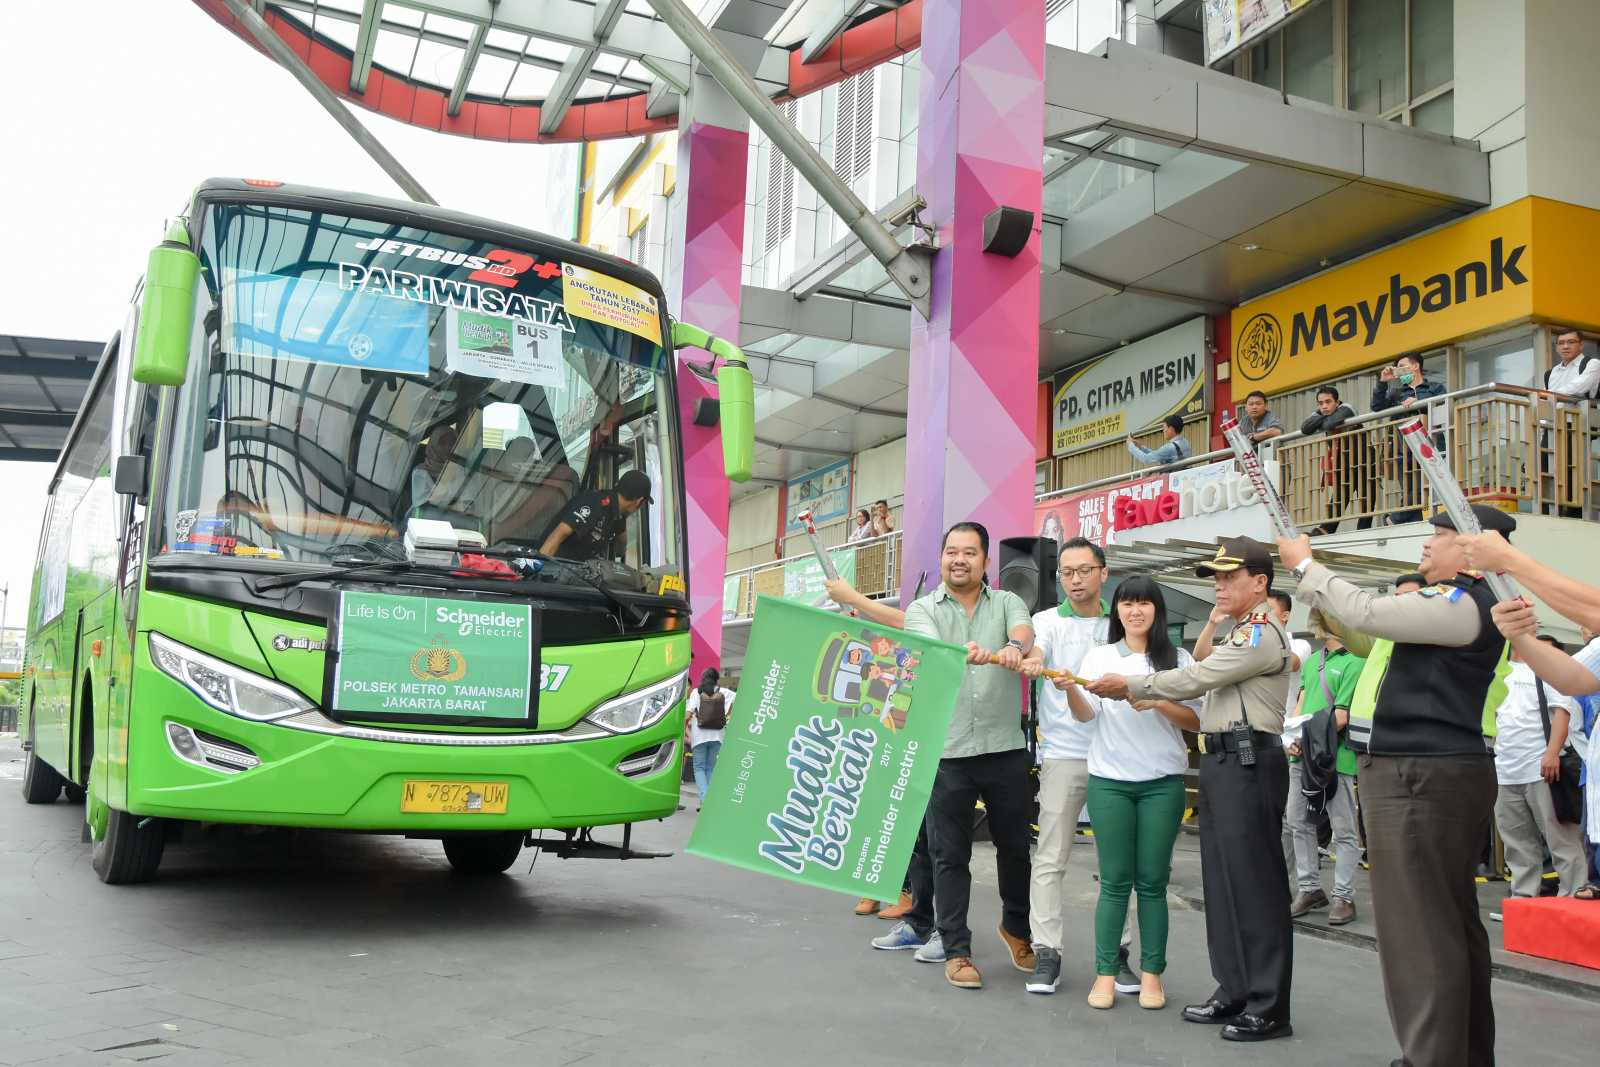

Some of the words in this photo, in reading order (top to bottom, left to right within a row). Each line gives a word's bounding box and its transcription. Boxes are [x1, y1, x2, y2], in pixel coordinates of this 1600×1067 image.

[355, 238, 490, 270] JETBUS
[338, 261, 576, 333] PARIWISATA
[570, 279, 619, 300] ANGKUTAN
[620, 294, 656, 316] LEBARAN
[590, 293, 620, 309] TAHUN
[621, 303, 641, 317] 2017
[1290, 236, 1528, 358] Maybank
[517, 324, 549, 340] BUS
[526, 340, 540, 359] 1
[1059, 397, 1082, 424] PD.
[1087, 376, 1135, 411] CITRA
[1140, 354, 1197, 395] MESIN
[1065, 433, 1082, 446] (021)
[1083, 429, 1096, 441] 300
[1098, 426, 1106, 437] 12
[1107, 422, 1121, 434] 777
[1079, 497, 1100, 517] SALE
[1078, 513, 1103, 538] 70%
[347, 603, 374, 618] Life
[377, 605, 390, 619] Is
[436, 606, 525, 628] Schneider
[474, 626, 523, 638] Electric
[343, 680, 397, 693] POLSEK
[400, 682, 447, 696] METRO
[453, 685, 525, 699] TAMANSARI
[748, 659, 781, 735] Schneider
[769, 664, 791, 707] Electric
[381, 696, 442, 710] JAKARTA
[445, 699, 488, 712] BARAT
[879, 742, 894, 768] 2017
[737, 768, 751, 781] Is
[405, 783, 416, 802] N
[429, 784, 474, 803] 7873
[483, 784, 507, 805] UW
[731, 782, 746, 804] Life
[759, 715, 844, 874] Mudik
[803, 728, 877, 871] Berkah
[865, 803, 899, 884] Schneider
[889, 740, 919, 801] Electric
[851, 836, 872, 880] Bersama
